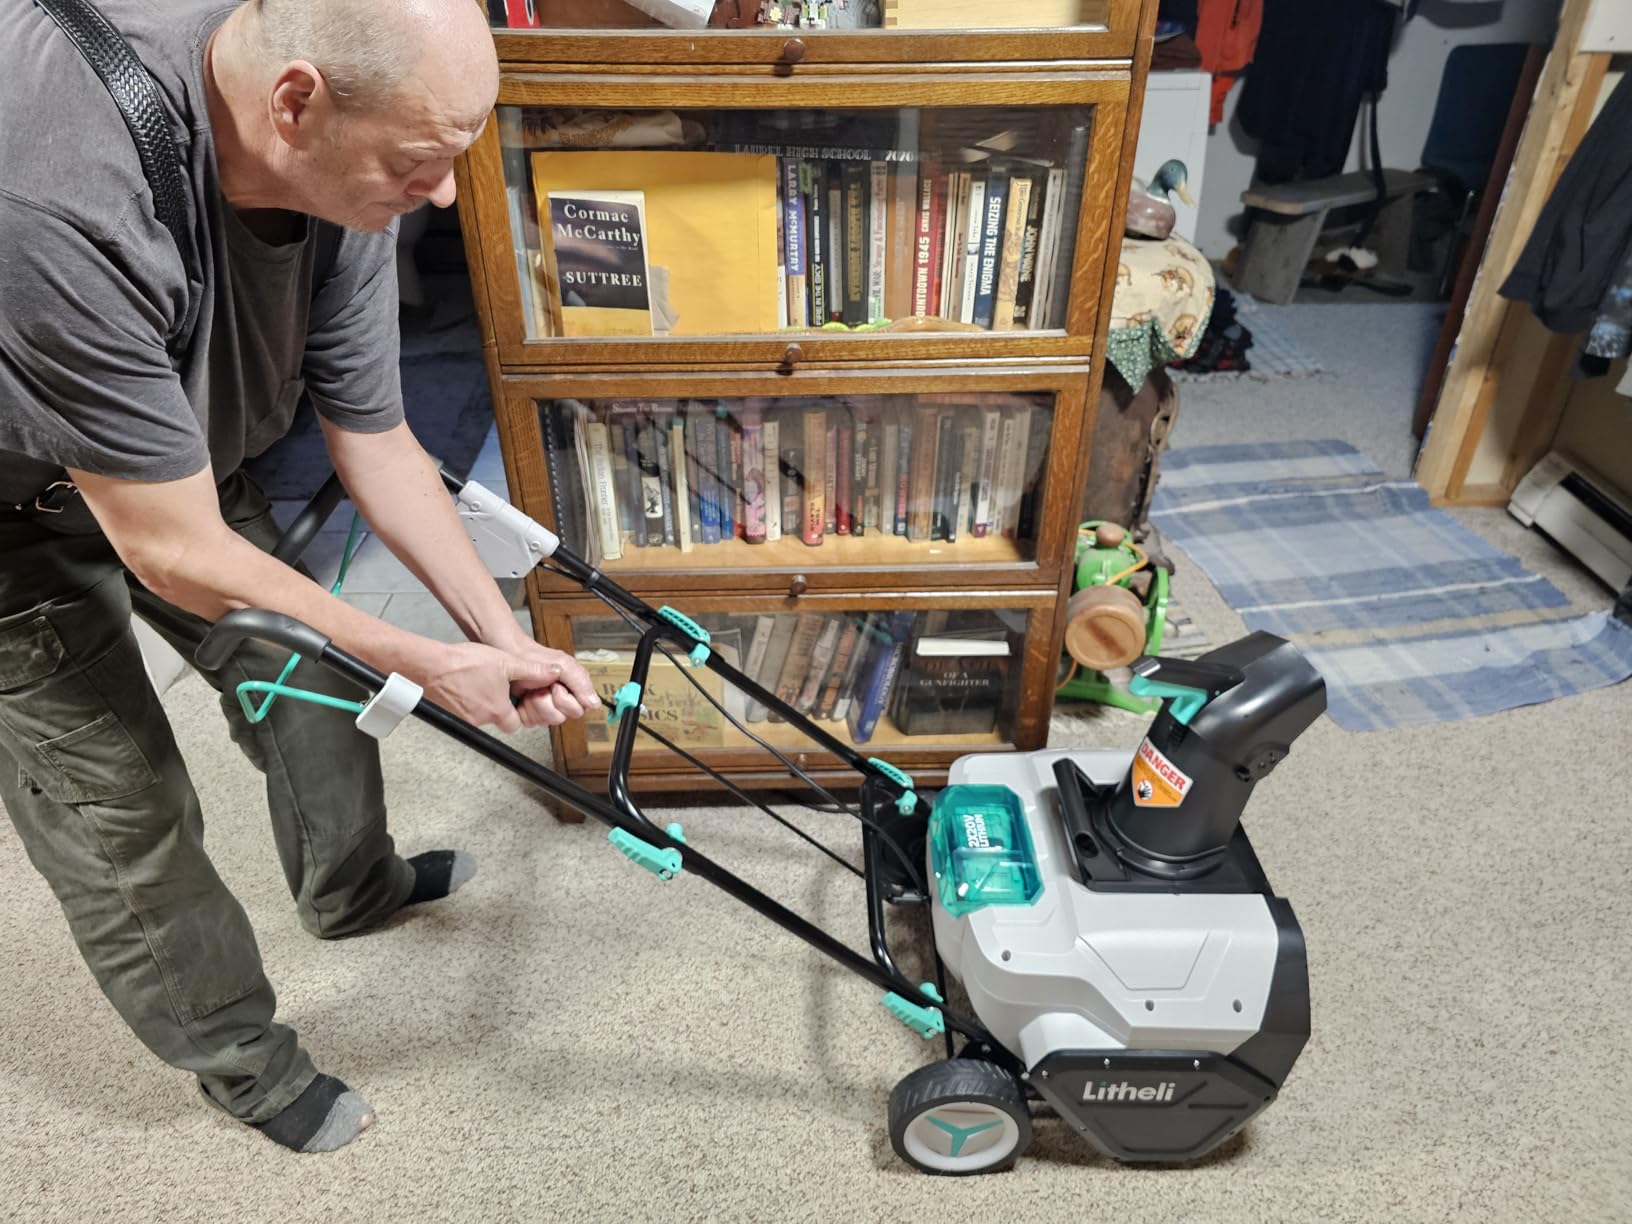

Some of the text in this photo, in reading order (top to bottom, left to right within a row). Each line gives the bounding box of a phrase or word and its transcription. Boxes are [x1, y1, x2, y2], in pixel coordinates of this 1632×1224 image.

[786, 145, 819, 158] HIGH
[821, 147, 872, 161] SCHOOL
[885, 149, 915, 162] 2020
[787, 164, 798, 206] LARRY
[564, 203, 629, 223] Cormac
[556, 223, 641, 246] McCarthy
[787, 209, 799, 272] McMURTRY
[979, 196, 1002, 296] SEIZING THE ENIGMA
[1023, 224, 1038, 254] JOHN
[918, 237, 930, 264] 1945
[565, 271, 643, 287] SUTTREE
[1019, 251, 1034, 283] WAYNE
[916, 267, 929, 317] OUNTDOWN
[919, 679, 990, 687] GUNFIGHTER
[943, 671, 959, 679] OF
[1140, 742, 1187, 790] DANGER
[963, 814, 980, 848] 2X20V
[974, 813, 990, 848] LITHIUM
[1083, 1080, 1176, 1102] Litheli
